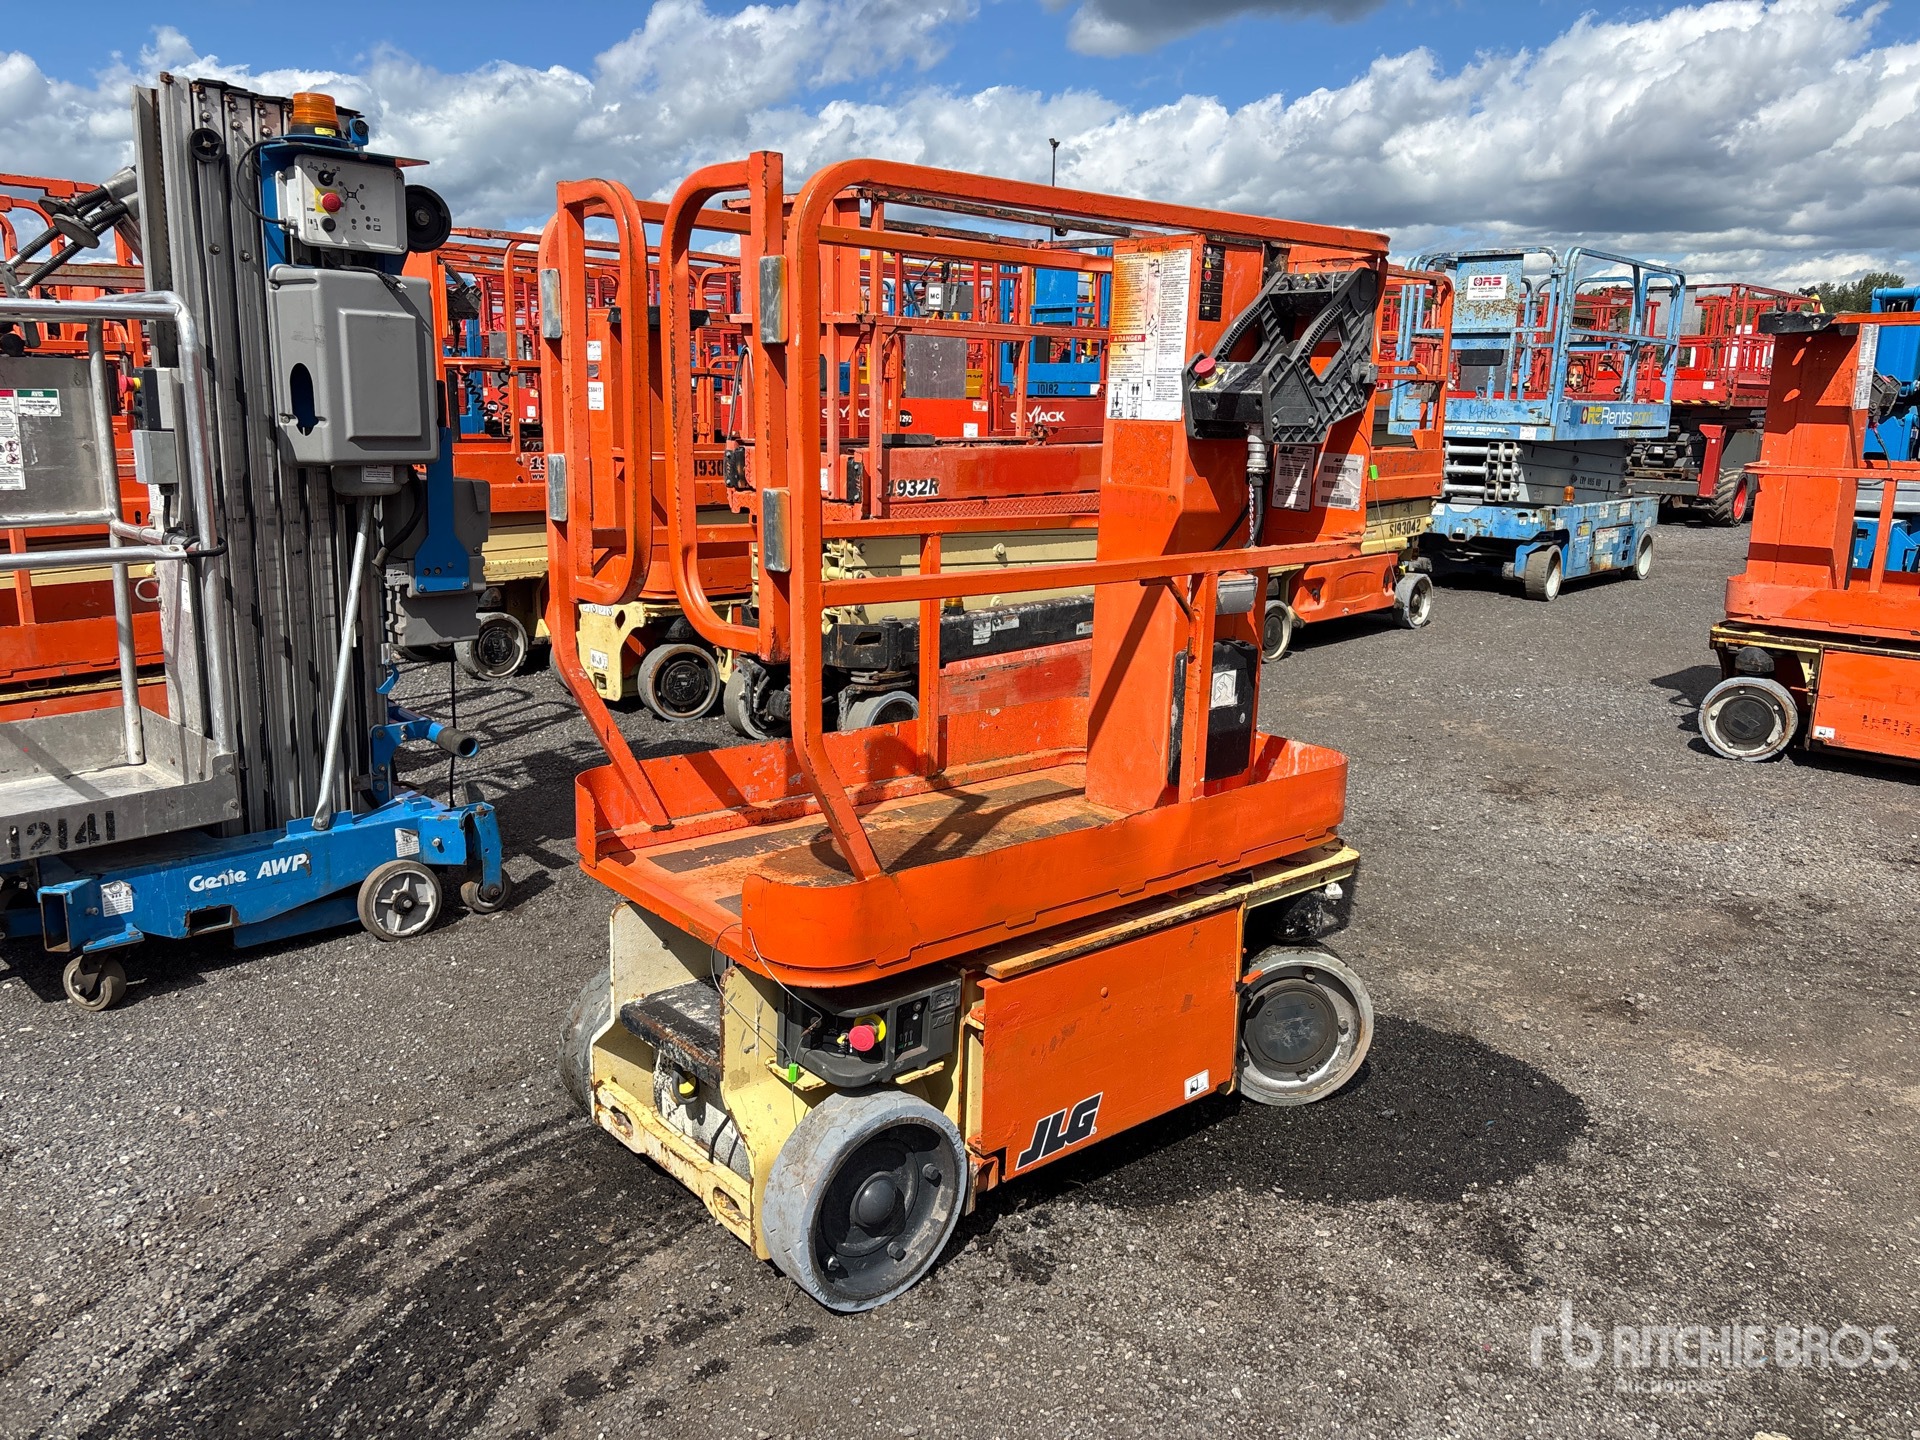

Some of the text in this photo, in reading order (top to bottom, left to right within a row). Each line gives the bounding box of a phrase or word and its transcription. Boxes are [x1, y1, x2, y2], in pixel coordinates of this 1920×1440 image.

[1038, 384, 1058, 394] 10182
[1010, 406, 1065, 422] SYJACK
[886, 478, 940, 496] 1932R
[7, 810, 116, 860] 12141
[188, 853, 309, 892] Genie AWP
[1014, 1091, 1104, 1172] JLG
